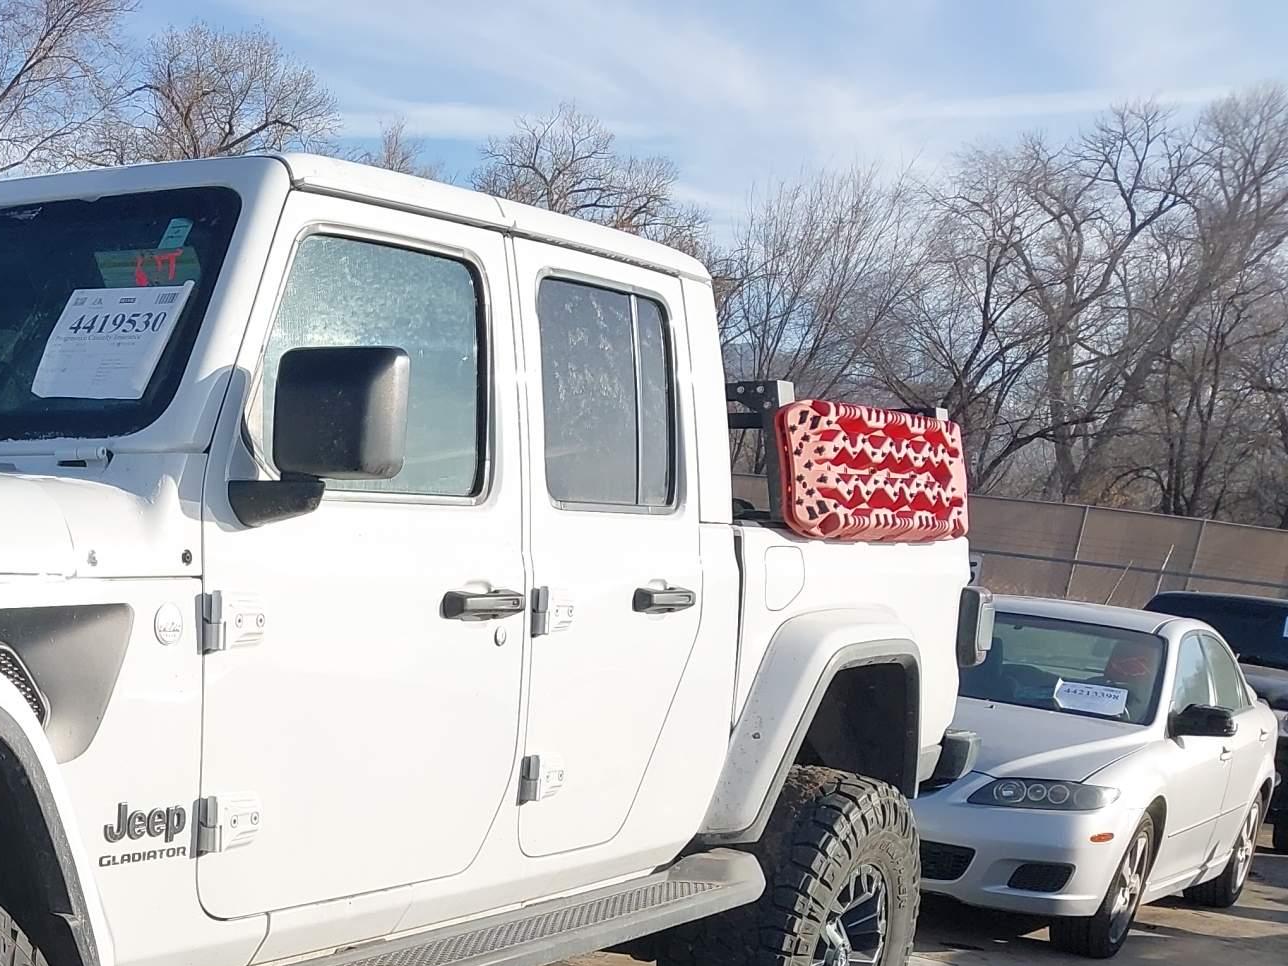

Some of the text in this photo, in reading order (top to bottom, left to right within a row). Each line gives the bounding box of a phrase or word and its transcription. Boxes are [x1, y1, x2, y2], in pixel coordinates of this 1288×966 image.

[69, 312, 167, 334] 4419530
[103, 802, 187, 843] Jeep
[98, 846, 187, 868] GLADIATOR
